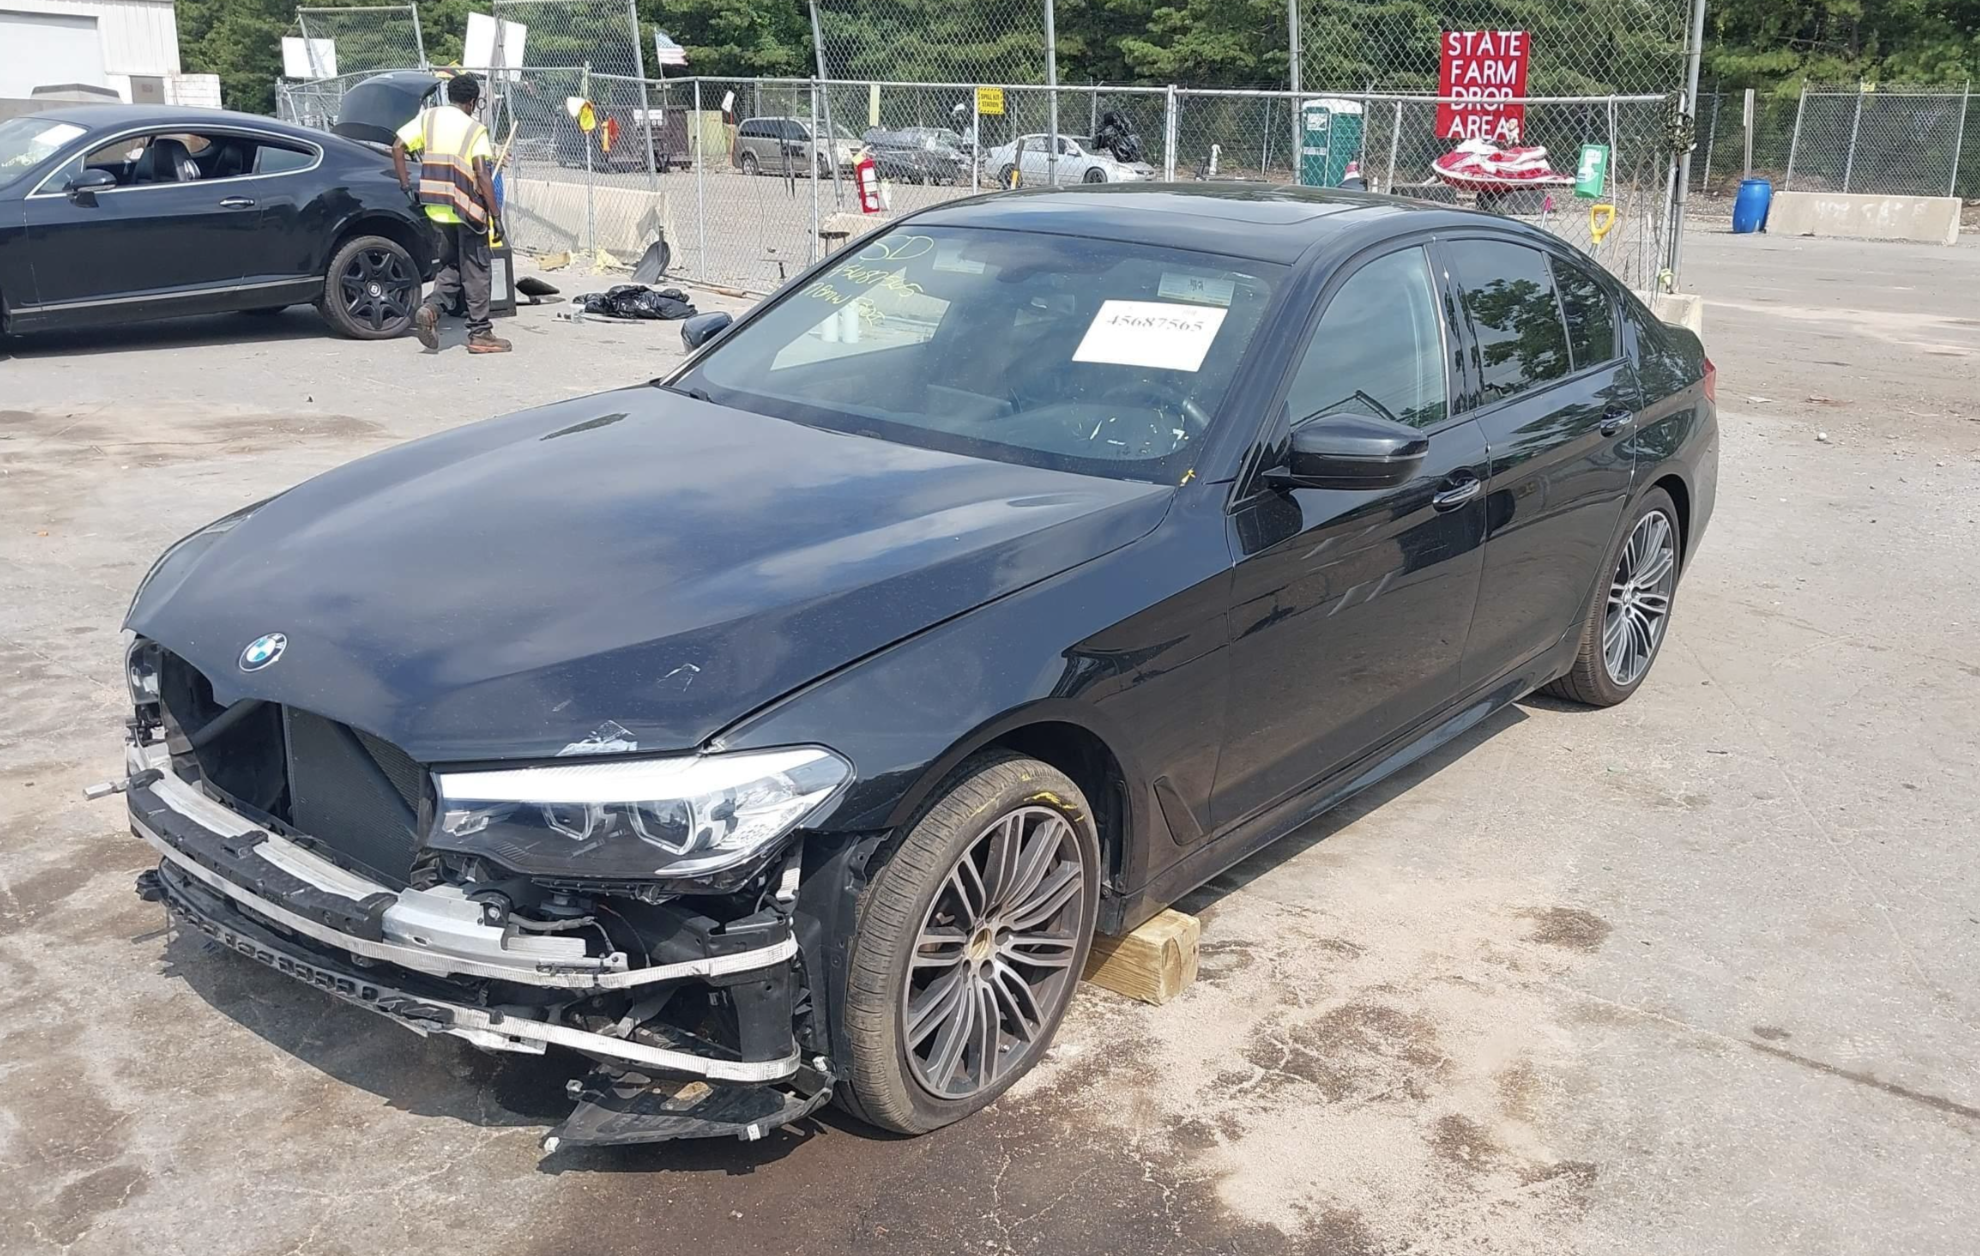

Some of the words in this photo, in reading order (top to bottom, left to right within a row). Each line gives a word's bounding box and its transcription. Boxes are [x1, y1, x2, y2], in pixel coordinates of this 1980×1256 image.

[1448, 31, 1522, 56] STATE
[1451, 60, 1517, 84] FARM
[1451, 87, 1513, 111] DROP
[1447, 115, 1510, 140] AREA
[1107, 315, 1205, 332] 45687565
